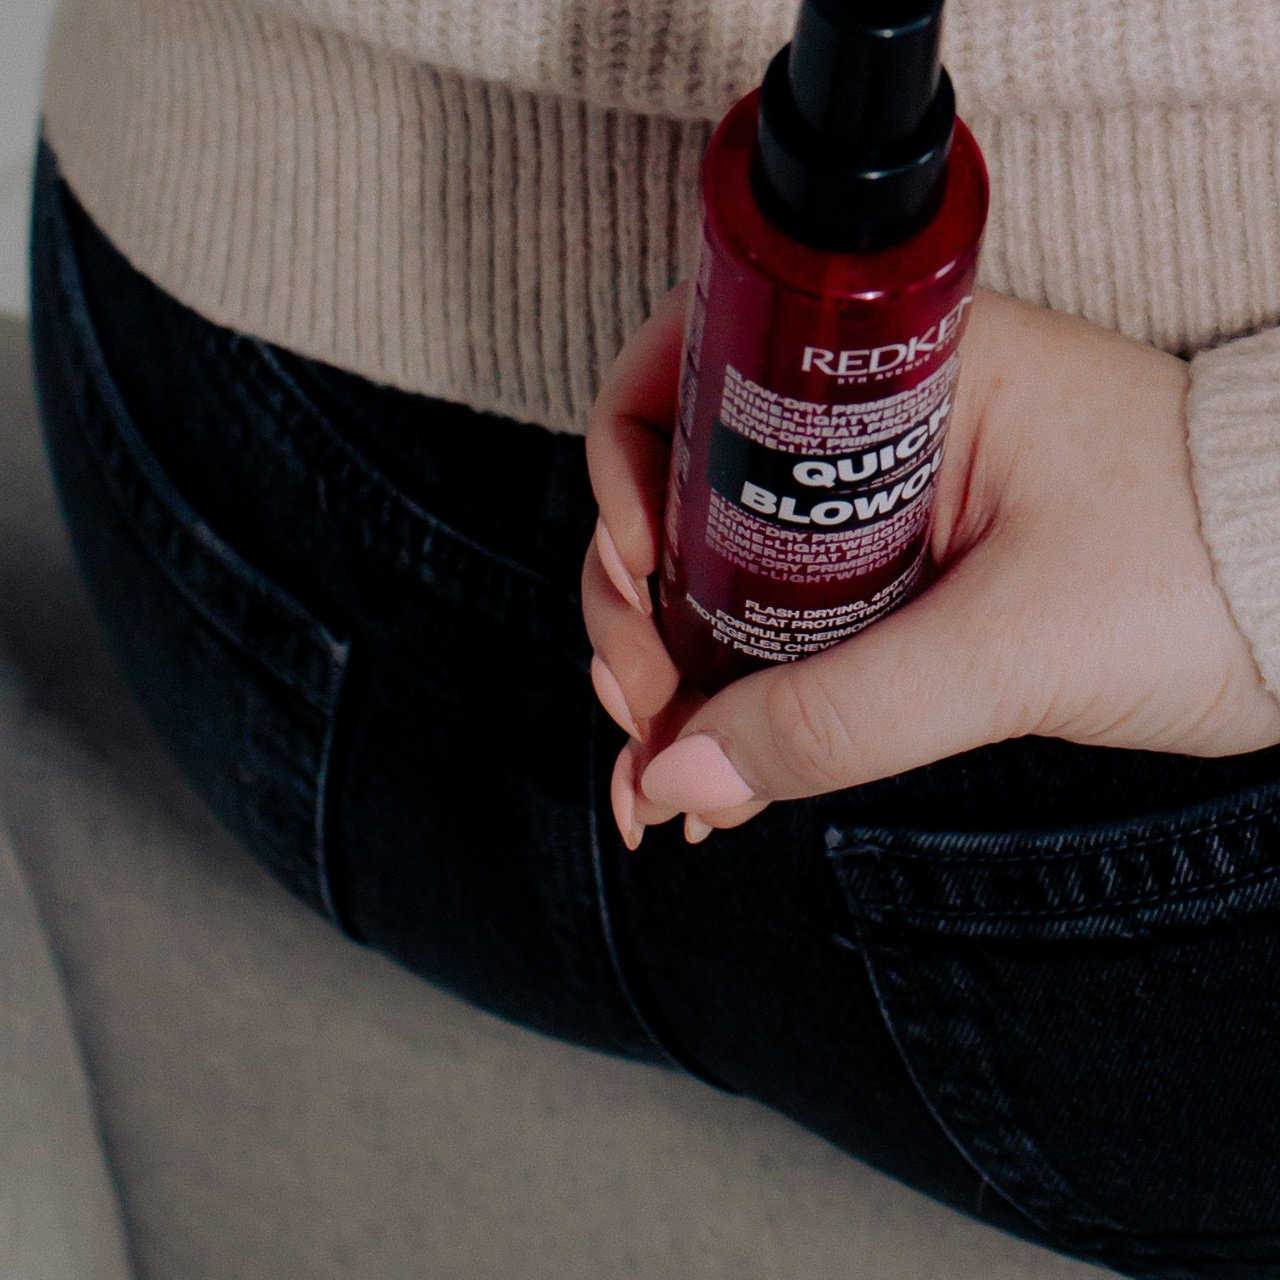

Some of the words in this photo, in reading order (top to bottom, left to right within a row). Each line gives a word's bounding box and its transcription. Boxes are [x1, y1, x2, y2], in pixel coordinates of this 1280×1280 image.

[793, 391, 950, 488] QUICK
[716, 609, 791, 642] FORMULE
[744, 610, 789, 628] HEAT
[791, 595, 890, 629] PROTECTING
[745, 600, 800, 619] FLASH
[713, 629, 732, 645] ET
[733, 640, 799, 662] PERMET
[750, 636, 782, 651] LES
